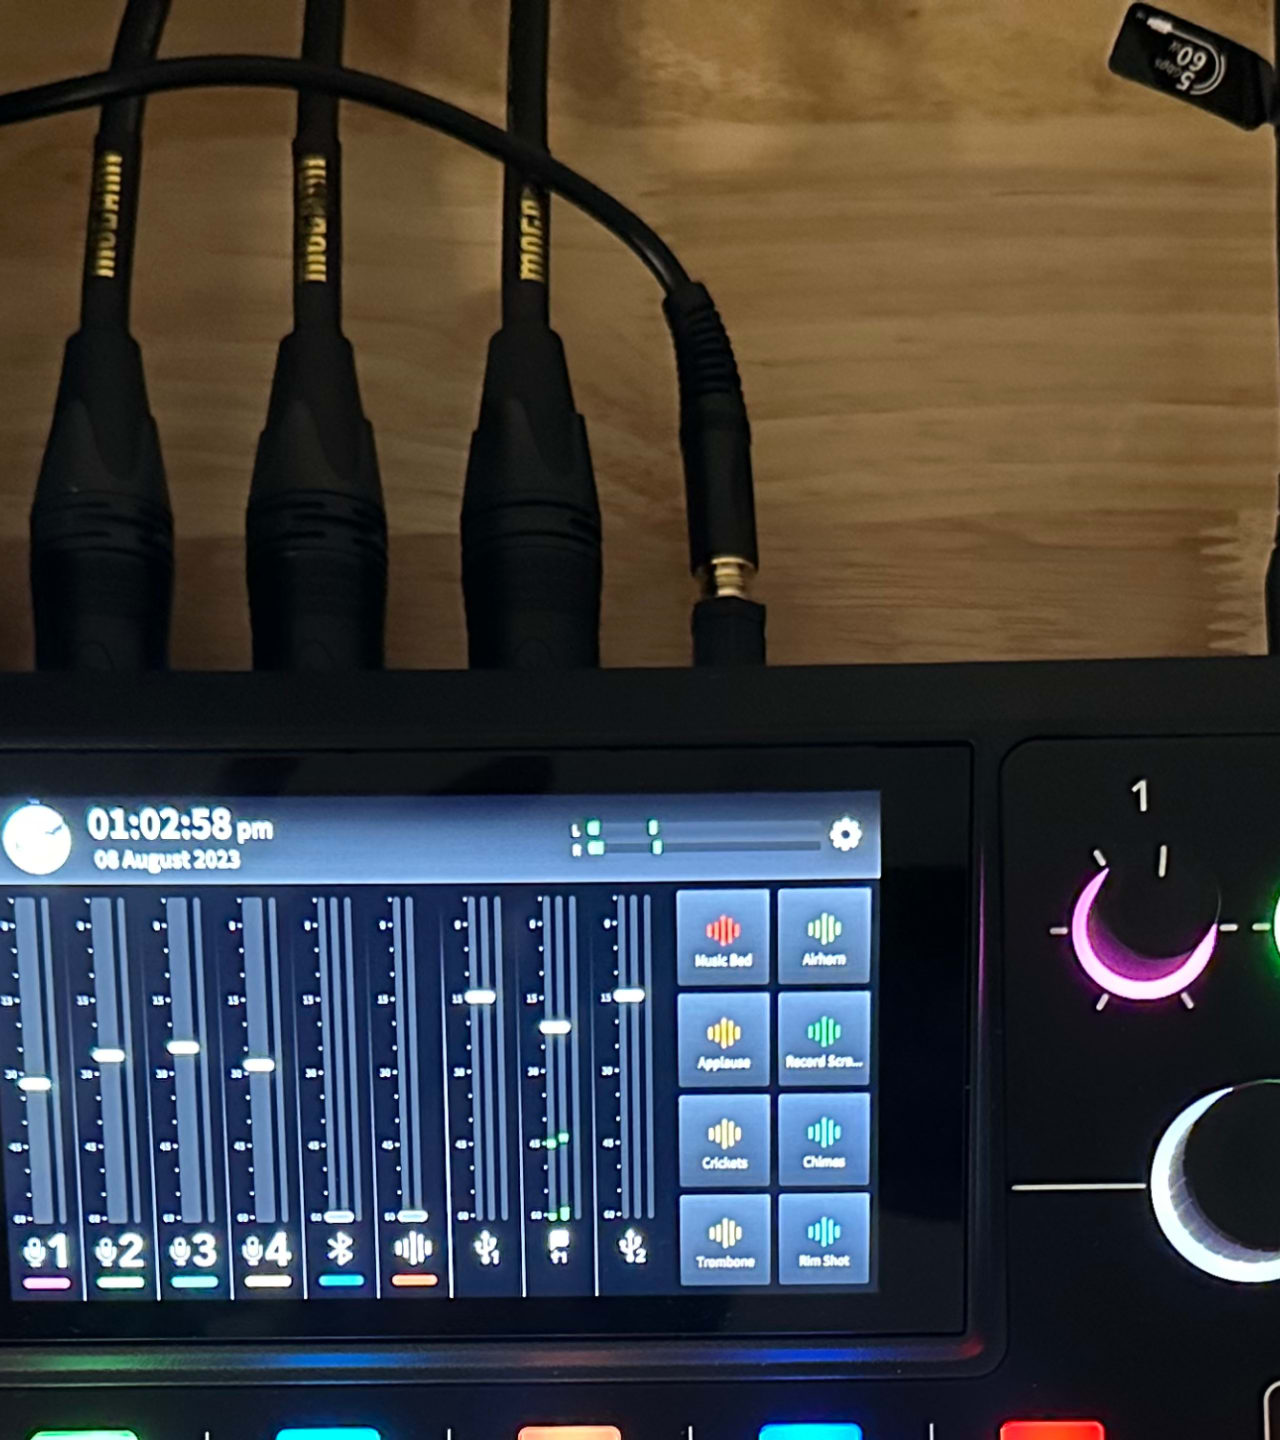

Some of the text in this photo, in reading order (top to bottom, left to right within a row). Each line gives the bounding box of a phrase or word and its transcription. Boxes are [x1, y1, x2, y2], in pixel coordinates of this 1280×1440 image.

[1131, 780, 1149, 812] 1
[87, 806, 274, 844] 01:02:58 pm
[122, 849, 191, 874] August
[193, 849, 241, 870] 2023
[801, 953, 847, 967] Airhorn
[696, 1056, 752, 1072] Applause
[785, 1054, 826, 1069] Record
[701, 1156, 750, 1170] Crickets
[802, 1155, 847, 1169] Chimes
[48, 1232, 68, 1269] 1
[118, 1232, 145, 1268] 2
[191, 1232, 218, 1268] 3
[265, 1230, 292, 1267] 4
[695, 1255, 756, 1269] Trombone
[798, 1254, 851, 1267] Rim Shot
